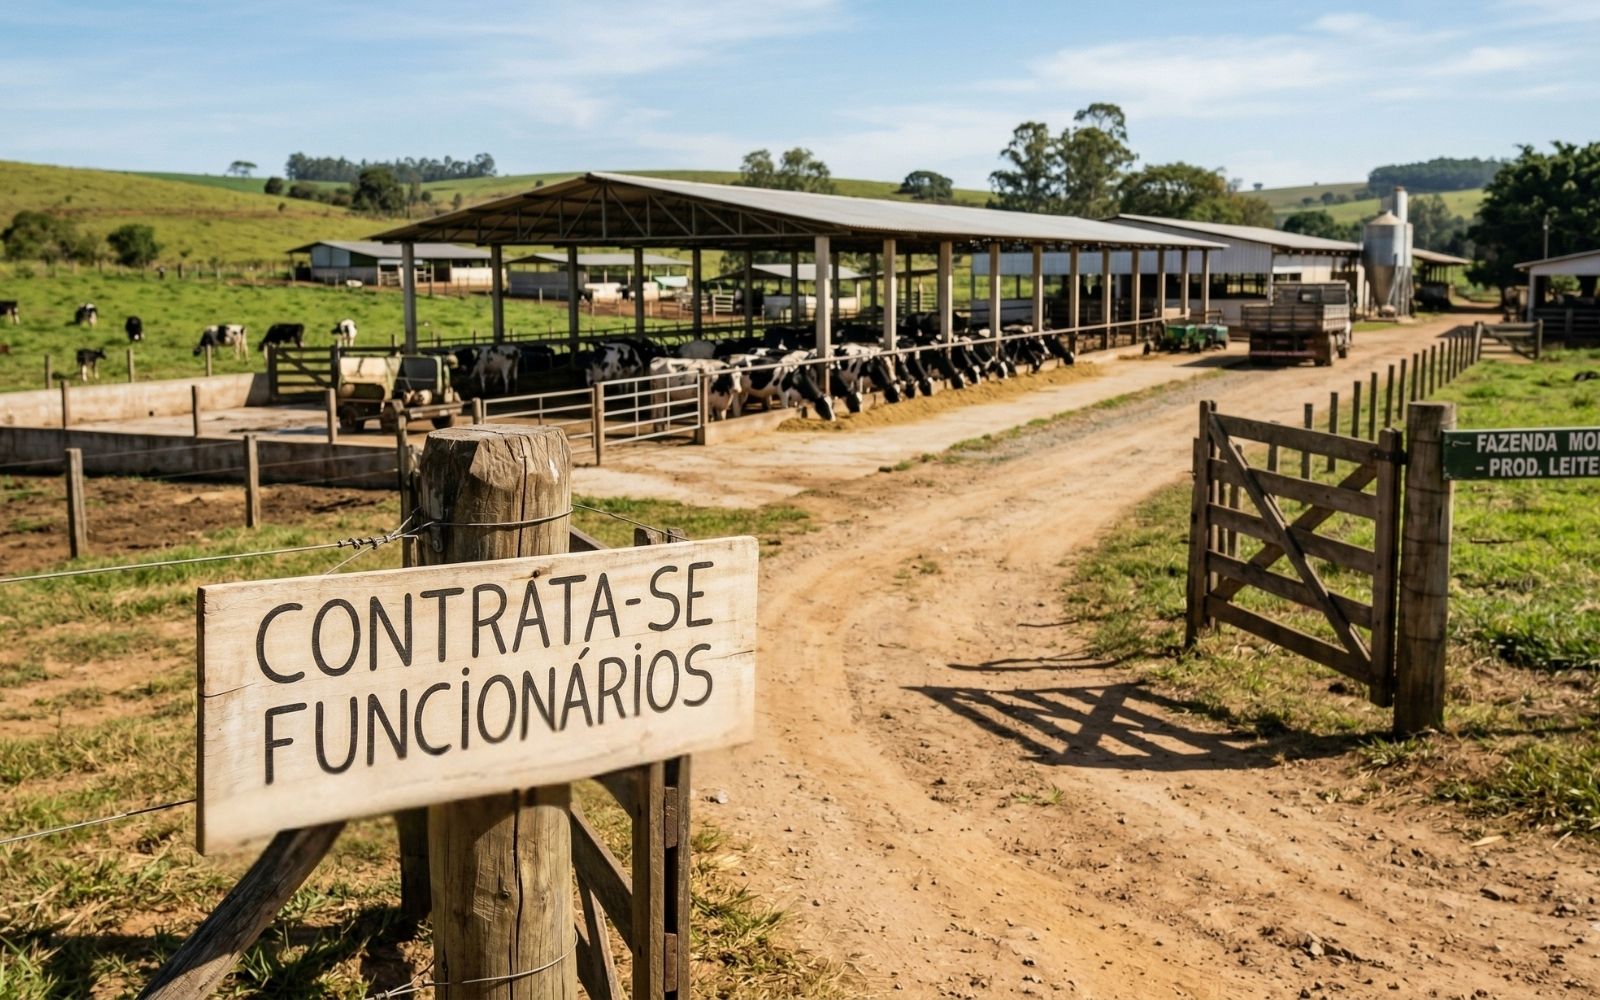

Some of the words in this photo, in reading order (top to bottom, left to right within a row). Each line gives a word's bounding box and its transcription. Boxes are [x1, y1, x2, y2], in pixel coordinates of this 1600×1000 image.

[1477, 432, 1557, 453] FAZENDA
[1569, 431, 1600, 452] MO
[1489, 457, 1543, 477] PROD.
[1549, 456, 1599, 476] LEITE
[256, 561, 714, 684] CONTRATA-SE
[264, 643, 714, 785] FUNCIONÁRIOS
